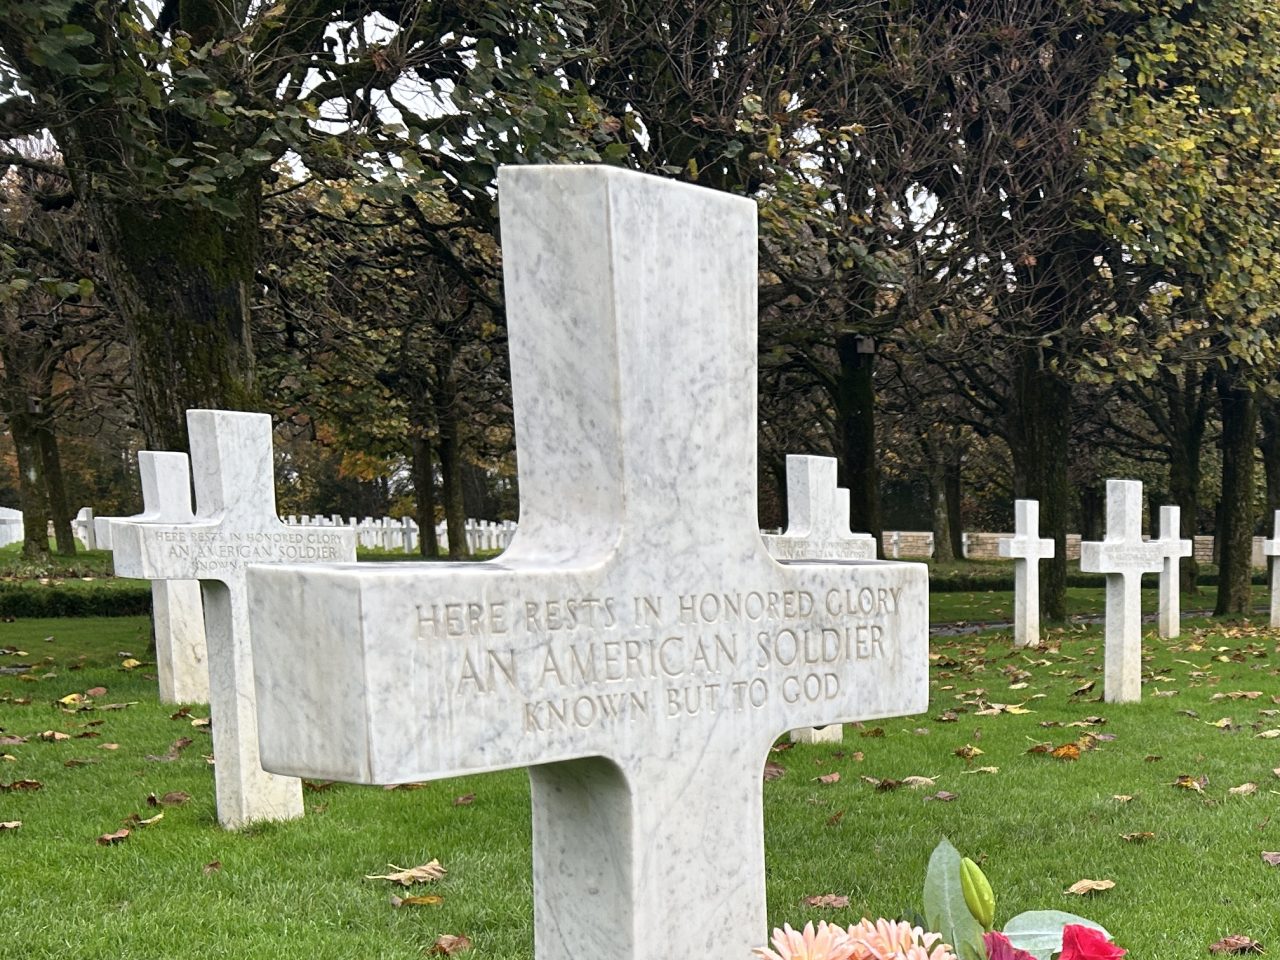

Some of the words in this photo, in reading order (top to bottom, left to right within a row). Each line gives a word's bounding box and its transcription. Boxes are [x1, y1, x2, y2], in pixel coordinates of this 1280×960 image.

[155, 531, 187, 542] HERE
[229, 532, 241, 542] IN
[246, 532, 304, 544] HONORED
[306, 533, 342, 545] GLORY
[169, 544, 190, 559] AN
[279, 545, 337, 560] SOLDIER
[415, 602, 508, 641] HERE
[525, 596, 618, 635] RESTS
[633, 595, 662, 628] IN
[679, 590, 815, 626] HONORED
[825, 586, 902, 618] GLORY
[457, 647, 519, 697] AN
[538, 632, 737, 692] AMERICAN
[756, 624, 885, 671] SOLDIER
[523, 690, 650, 735] KNOWN
[666, 683, 721, 719] BUT
[732, 677, 768, 711] TO
[782, 672, 840, 704] GOD
